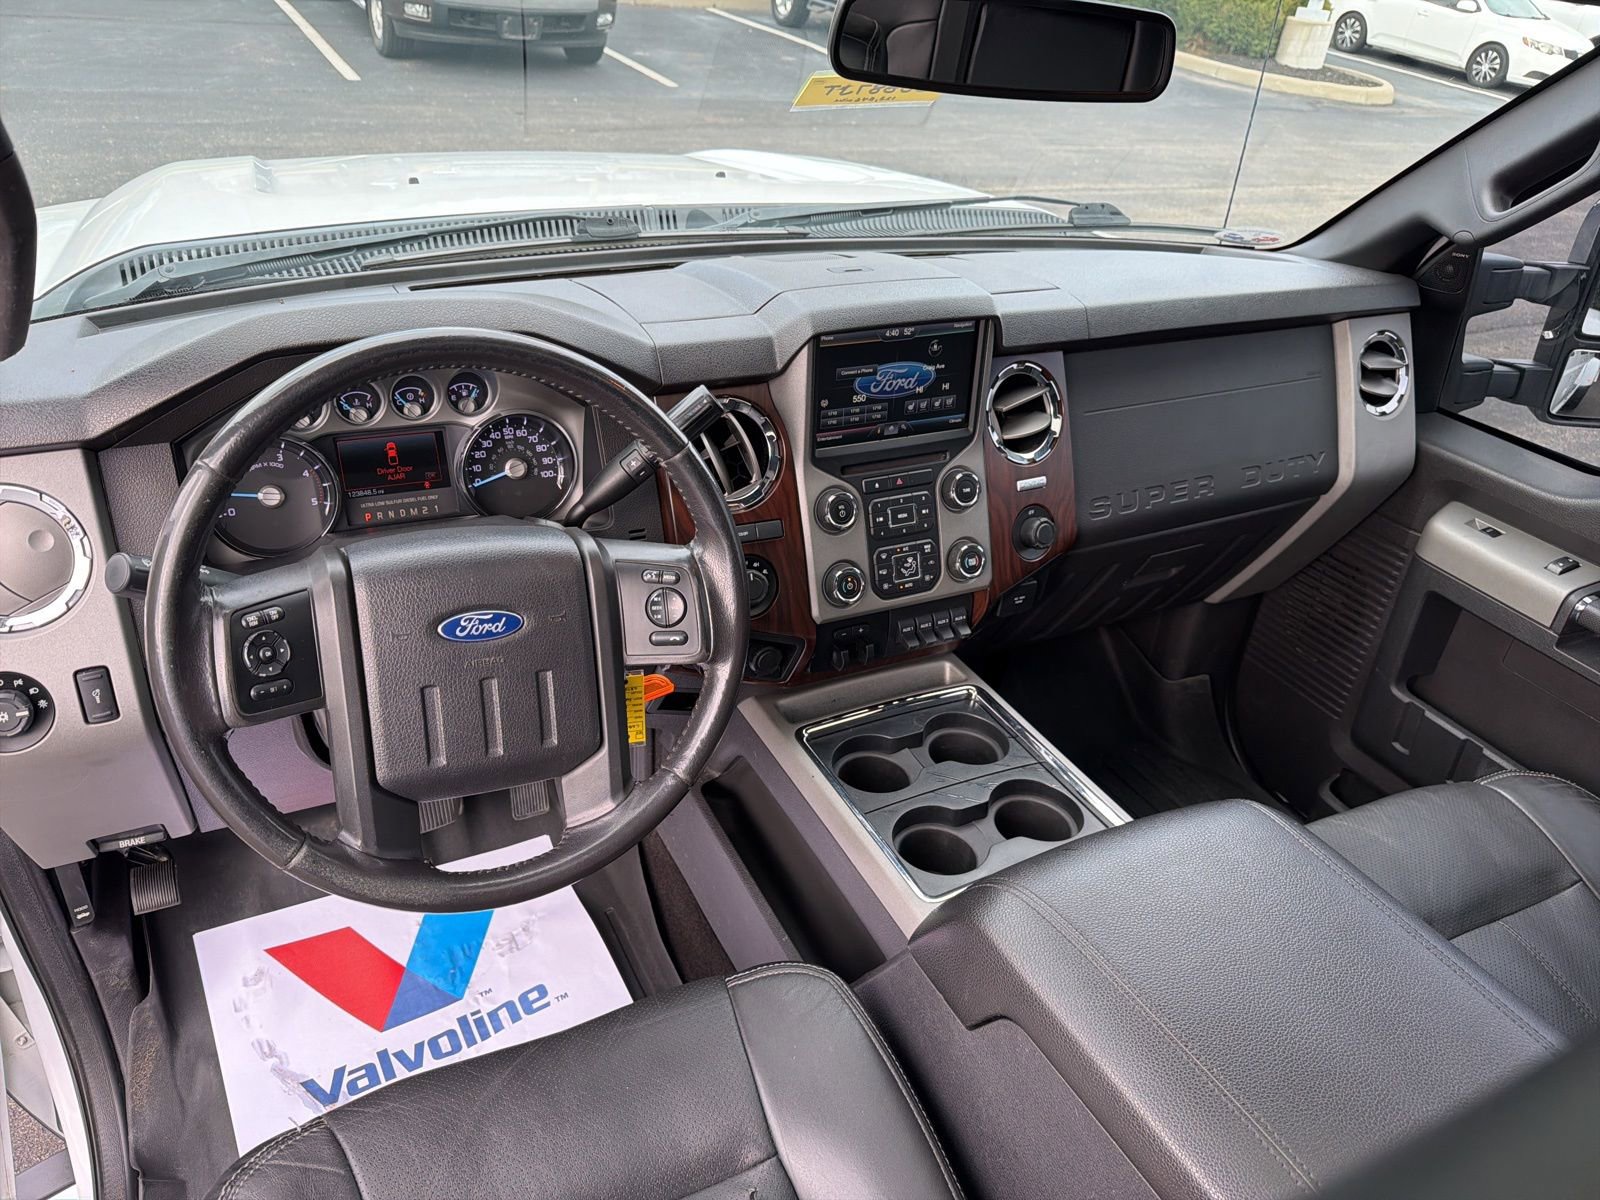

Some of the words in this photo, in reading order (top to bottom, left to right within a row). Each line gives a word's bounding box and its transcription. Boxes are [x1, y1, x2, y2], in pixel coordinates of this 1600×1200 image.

[885, 328, 900, 337] 4:40
[870, 368, 919, 393] Ford
[489, 431, 501, 440] 40
[502, 427, 514, 435] 50
[515, 429, 528, 437] 60
[527, 435, 539, 443] 70
[816, 434, 843, 442] Entertainment
[481, 439, 493, 448] 30
[535, 444, 547, 452] 80
[276, 453, 284, 462] 3
[474, 450, 487, 459] 20
[269, 461, 285, 469] 1000
[541, 456, 553, 465] 90
[376, 467, 396, 475] Driver
[472, 464, 482, 472] 10
[302, 469, 309, 477] 4
[387, 473, 406, 481] AJAR
[540, 470, 554, 478] 100
[1088, 474, 1215, 521] SUPER
[1240, 450, 1326, 489] DUTY
[311, 498, 318, 506] 5
[228, 508, 236, 516] 0
[365, 512, 371, 522] P
[377, 512, 384, 520] R
[388, 510, 395, 519] N
[400, 509, 406, 517] D
[410, 508, 418, 516] M
[422, 506, 429, 514] 2
[434, 504, 439, 512] 1
[455, 613, 506, 637] Ford
[464, 656, 504, 670] AIRBAG
[118, 836, 146, 848] BRAKE
[478, 987, 493, 998] TM
[299, 983, 552, 1108] Valvoline
[554, 991, 570, 1004] TM
